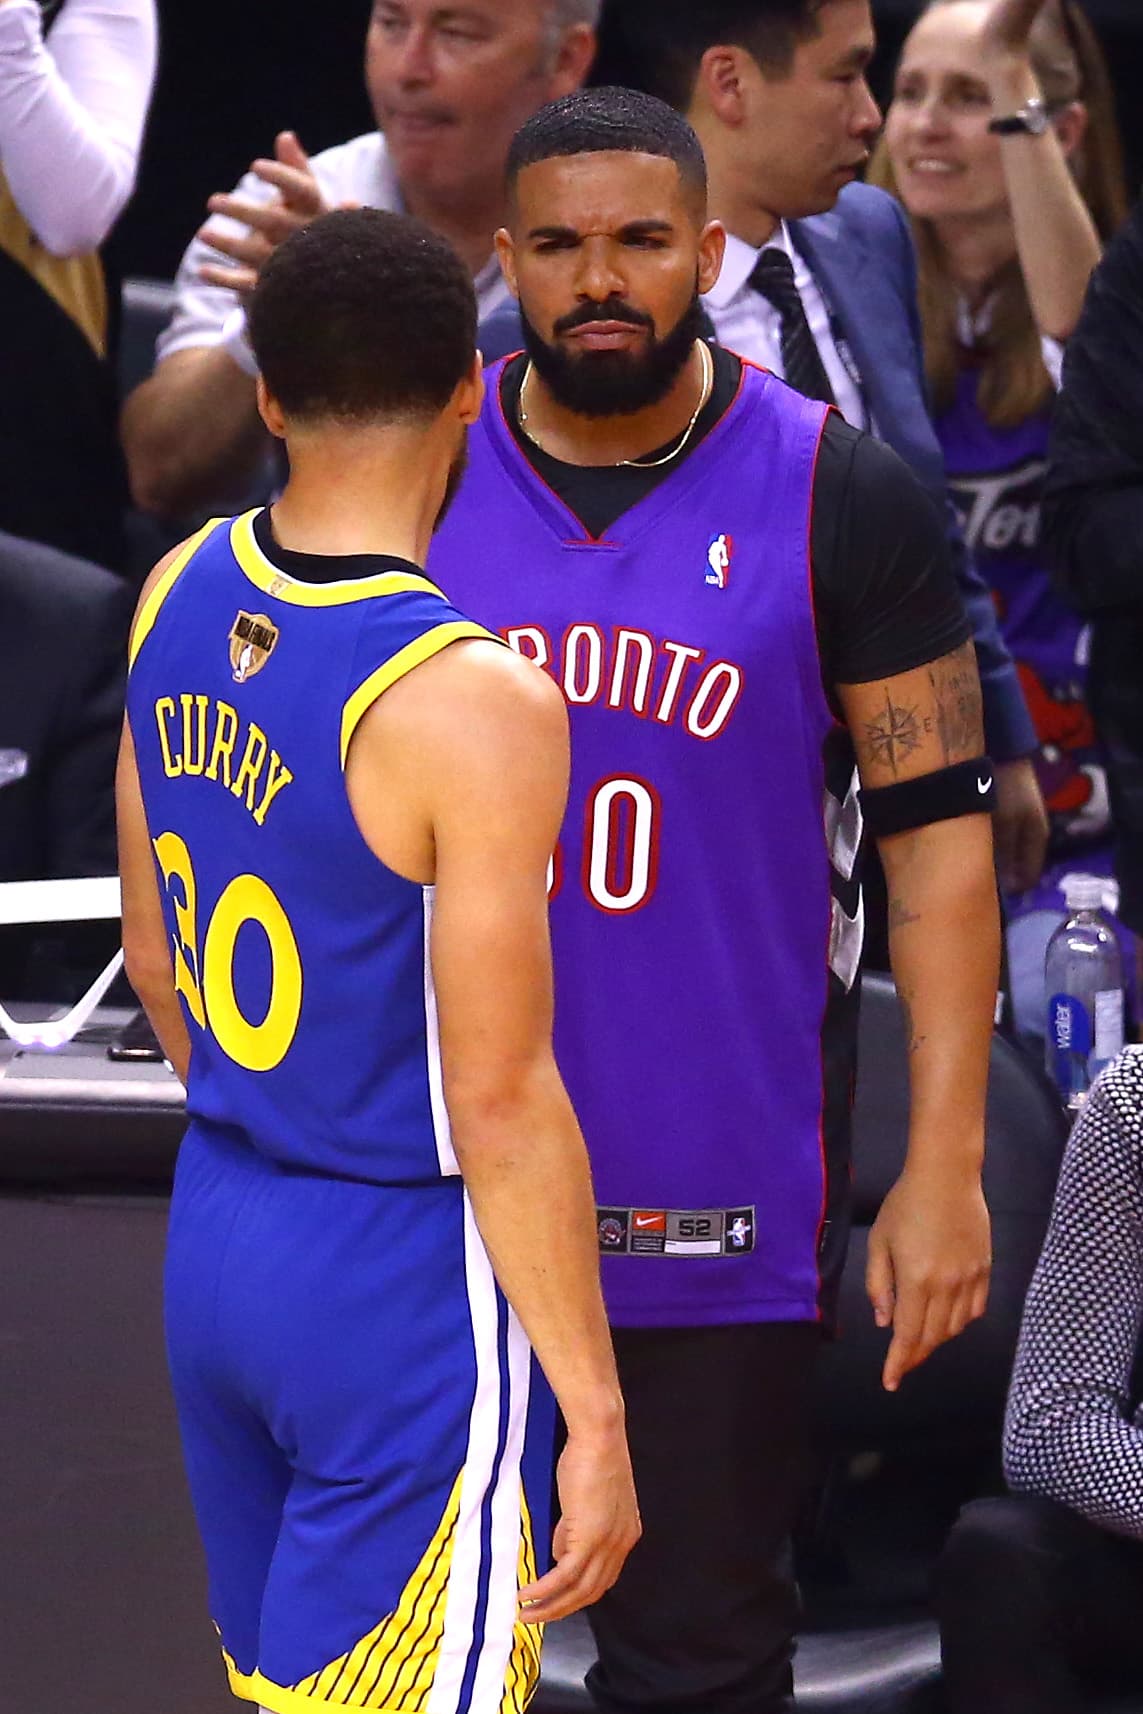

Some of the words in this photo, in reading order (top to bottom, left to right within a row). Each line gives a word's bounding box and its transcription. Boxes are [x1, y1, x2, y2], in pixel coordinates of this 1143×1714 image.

[155, 693, 294, 826] CURRY
[545, 772, 661, 915] 0
[1054, 1002, 1073, 1049] water
[678, 1219, 711, 1237] 52
